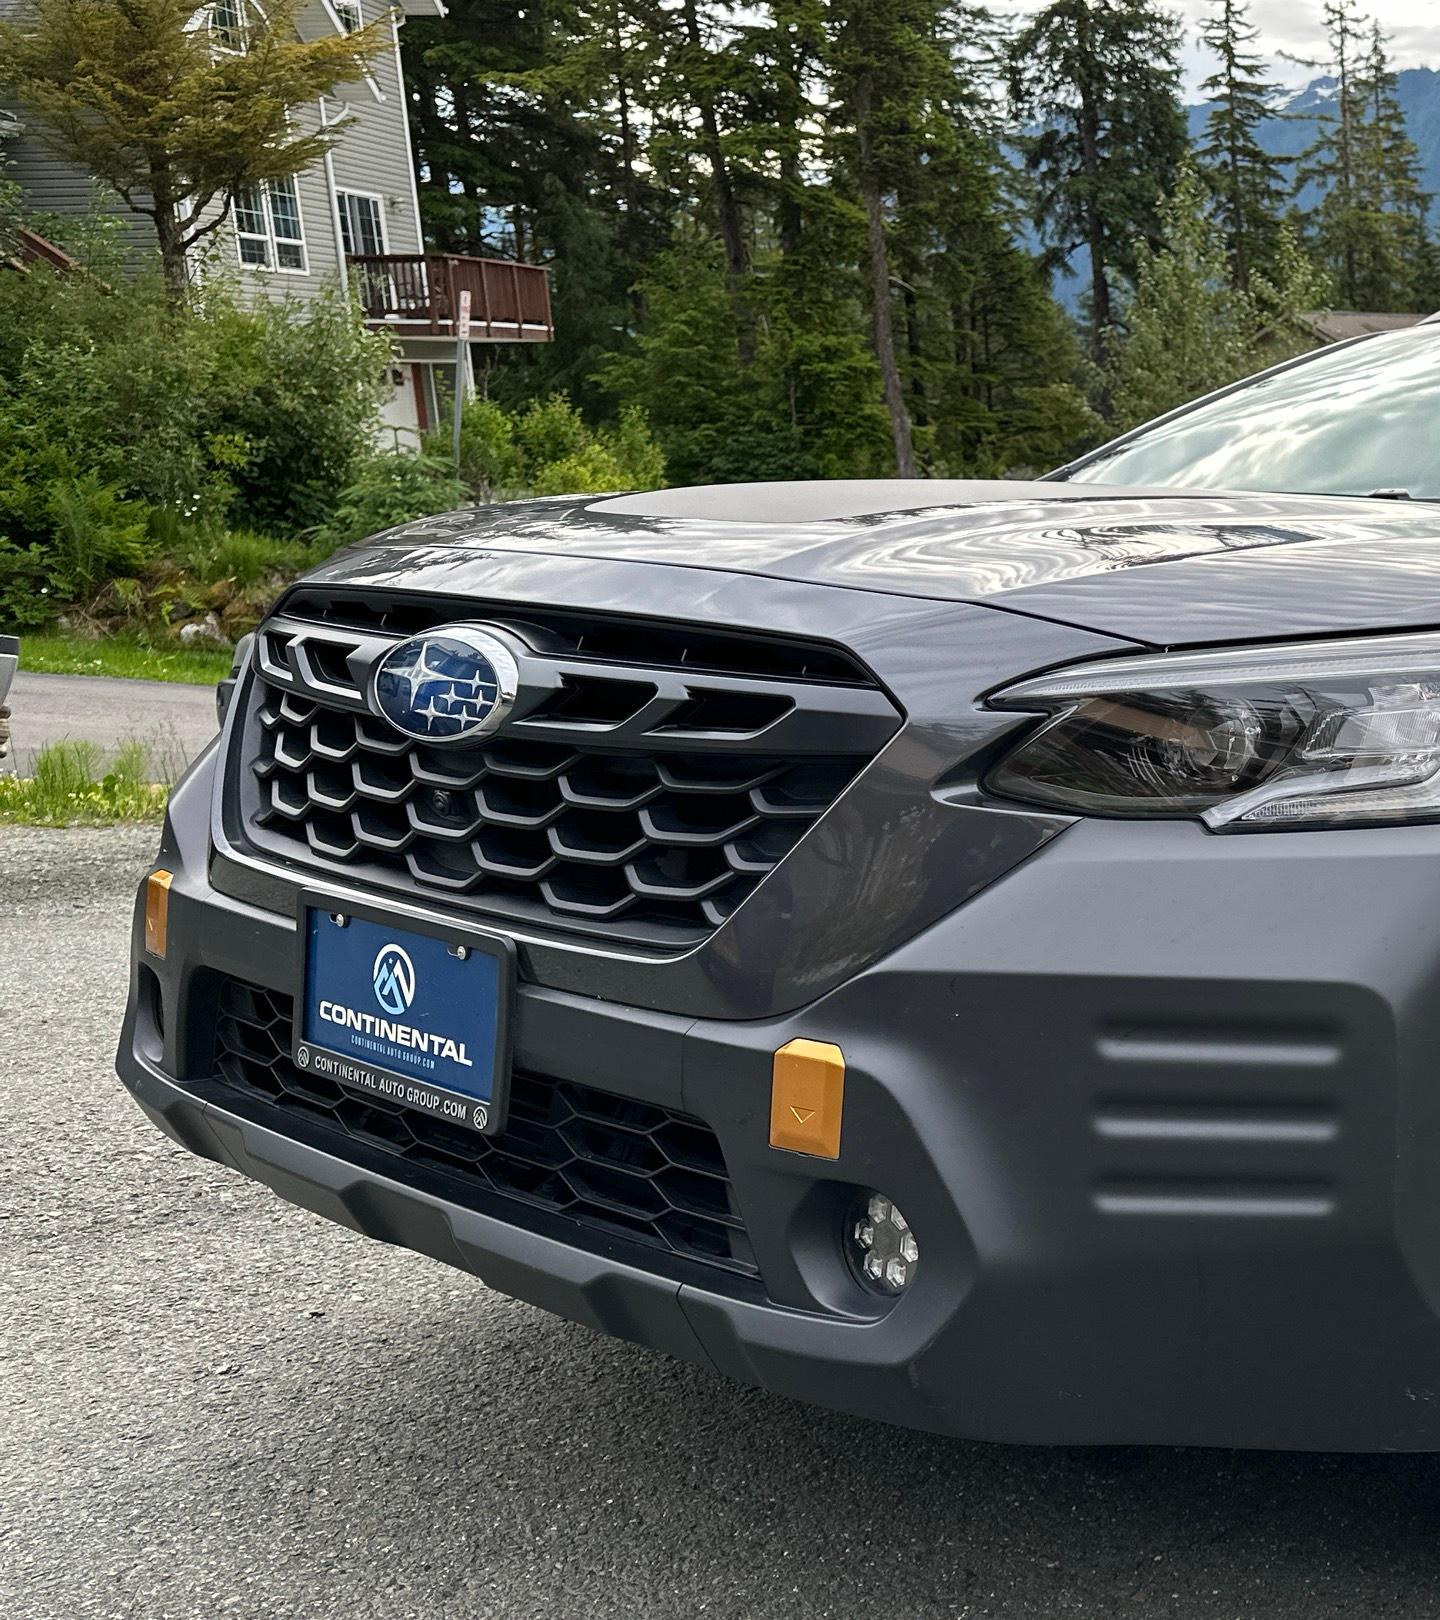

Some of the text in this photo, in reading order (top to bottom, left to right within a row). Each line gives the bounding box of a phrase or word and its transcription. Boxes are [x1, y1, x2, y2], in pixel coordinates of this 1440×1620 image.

[319, 1000, 473, 1067] CONTINENTAL
[314, 1055, 376, 1089] CONTINENTAL
[379, 1078, 404, 1098] AUTO
